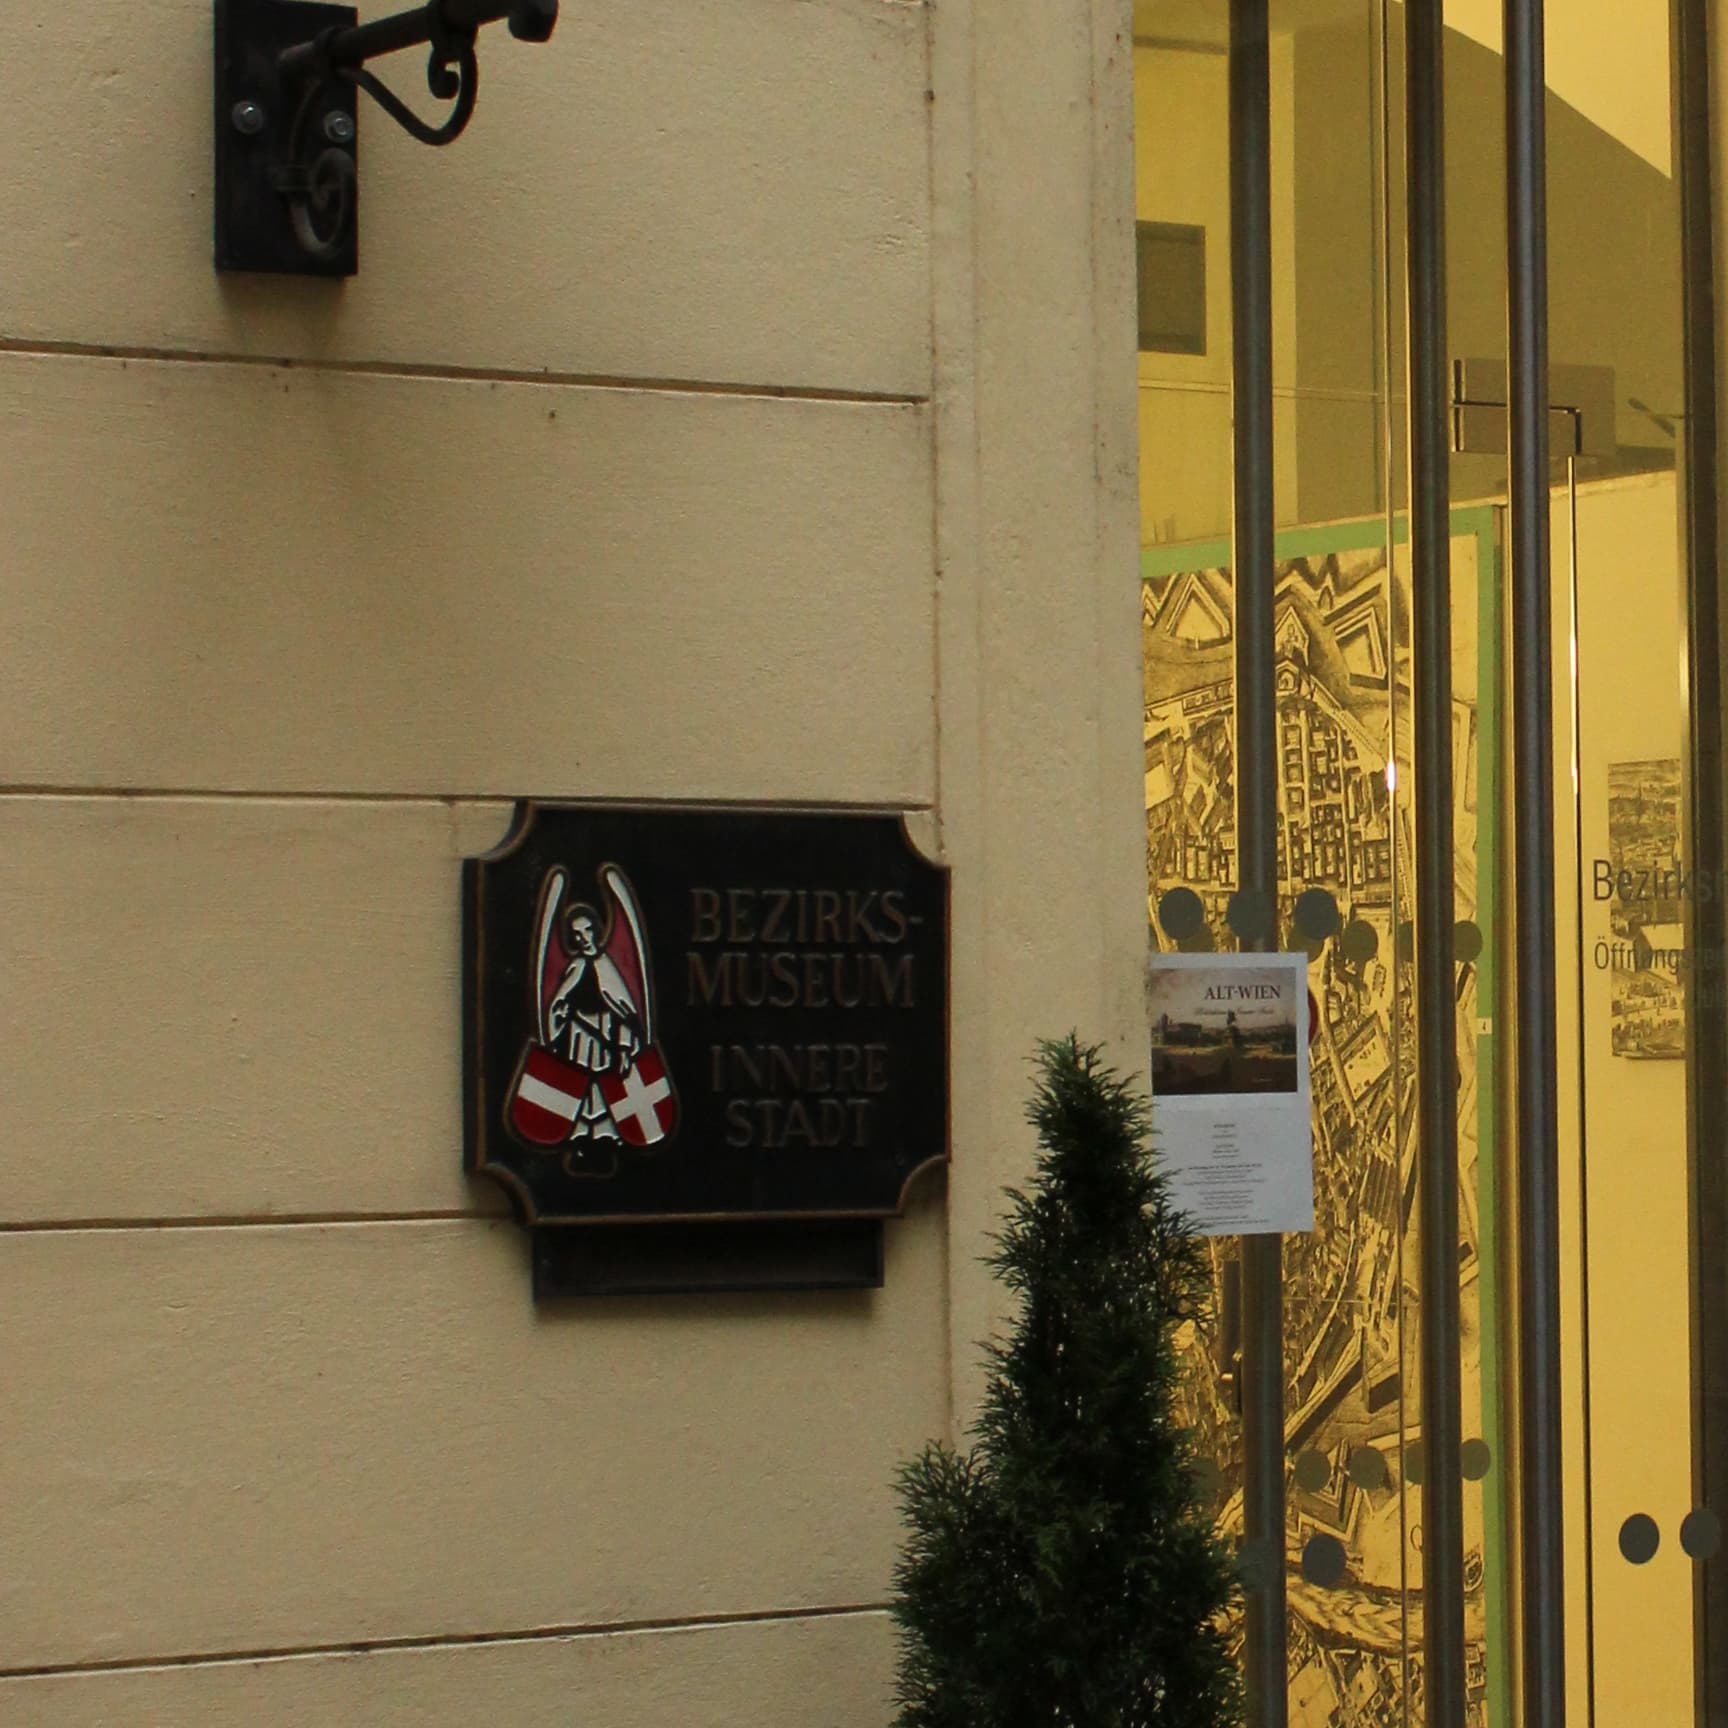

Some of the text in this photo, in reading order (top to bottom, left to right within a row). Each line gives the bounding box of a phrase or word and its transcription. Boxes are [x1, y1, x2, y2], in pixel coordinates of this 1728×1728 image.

[687, 887, 924, 944] BEZIRKS-
[686, 952, 916, 1009] MUSEUM
[1204, 984, 1281, 1001] ALT-WIEN
[709, 1043, 890, 1094] INNERE
[724, 1098, 874, 1149] STADT
